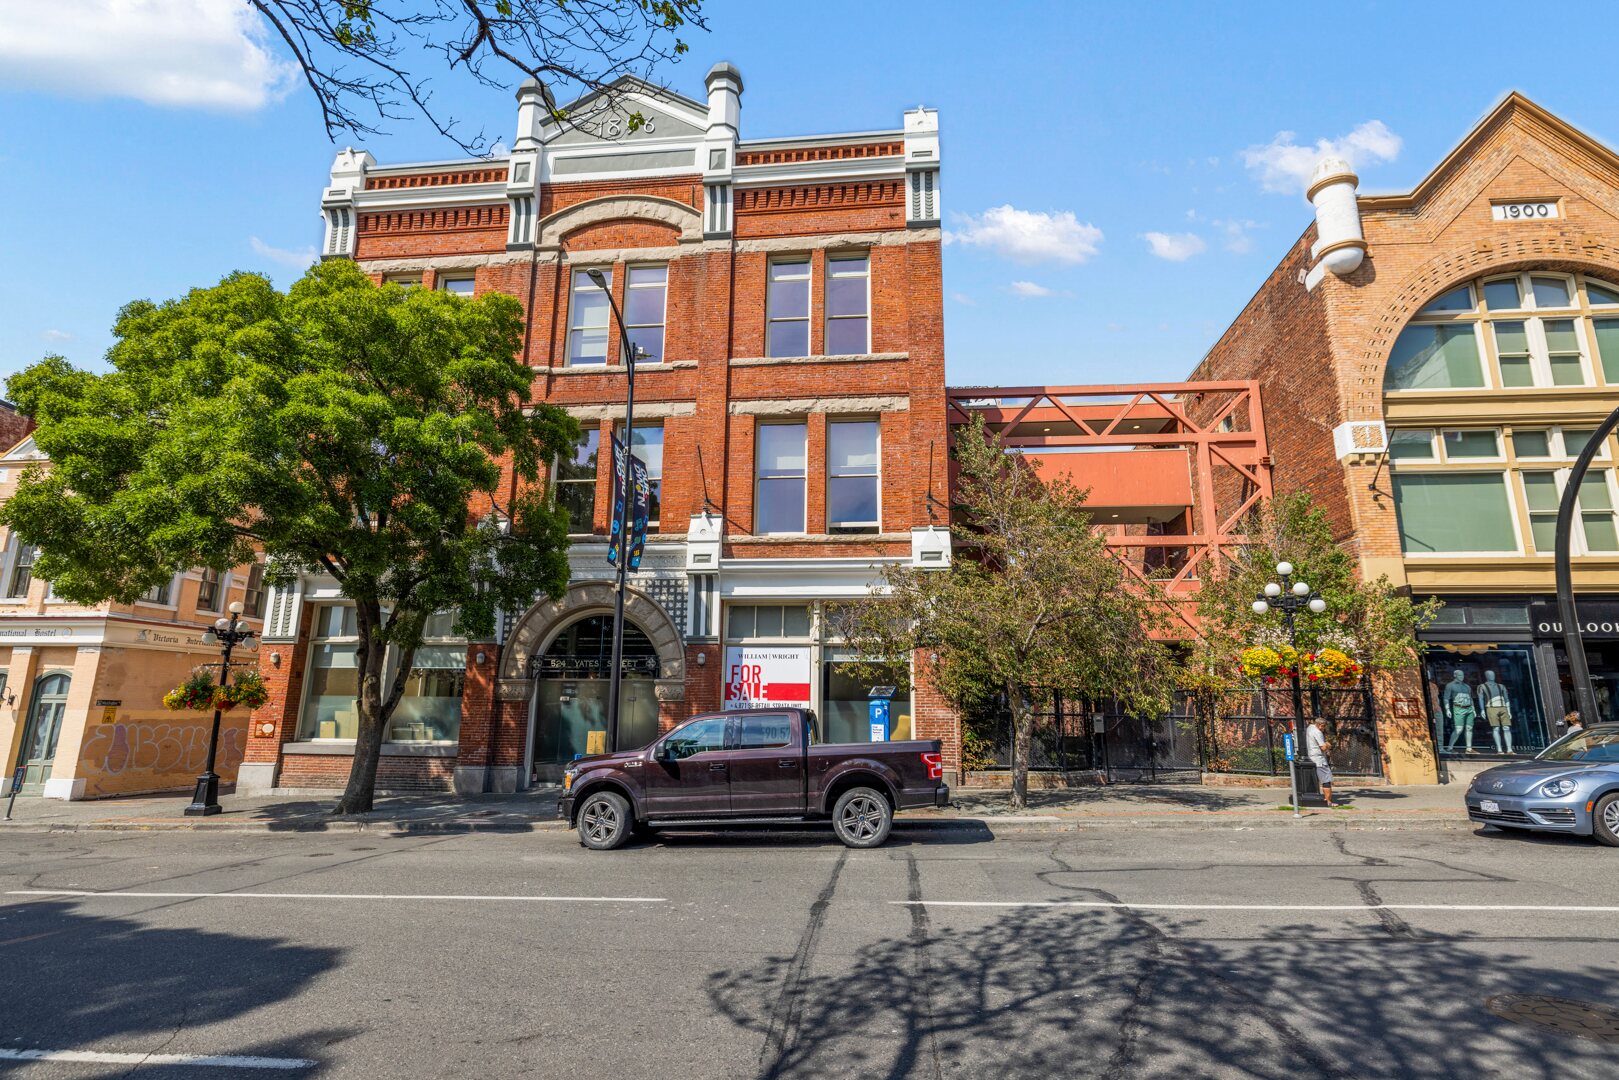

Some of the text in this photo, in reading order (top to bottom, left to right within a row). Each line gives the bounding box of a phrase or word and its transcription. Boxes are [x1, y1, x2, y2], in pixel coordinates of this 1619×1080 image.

[1502, 204, 1549, 219] 1900
[1538, 622, 1619, 633] OULOO
[153, 633, 179, 643] Victoria
[550, 660, 639, 668] 524 YATES SEET
[731, 664, 762, 683] FOR
[730, 683, 768, 701] SALE
[874, 707, 883, 719] P
